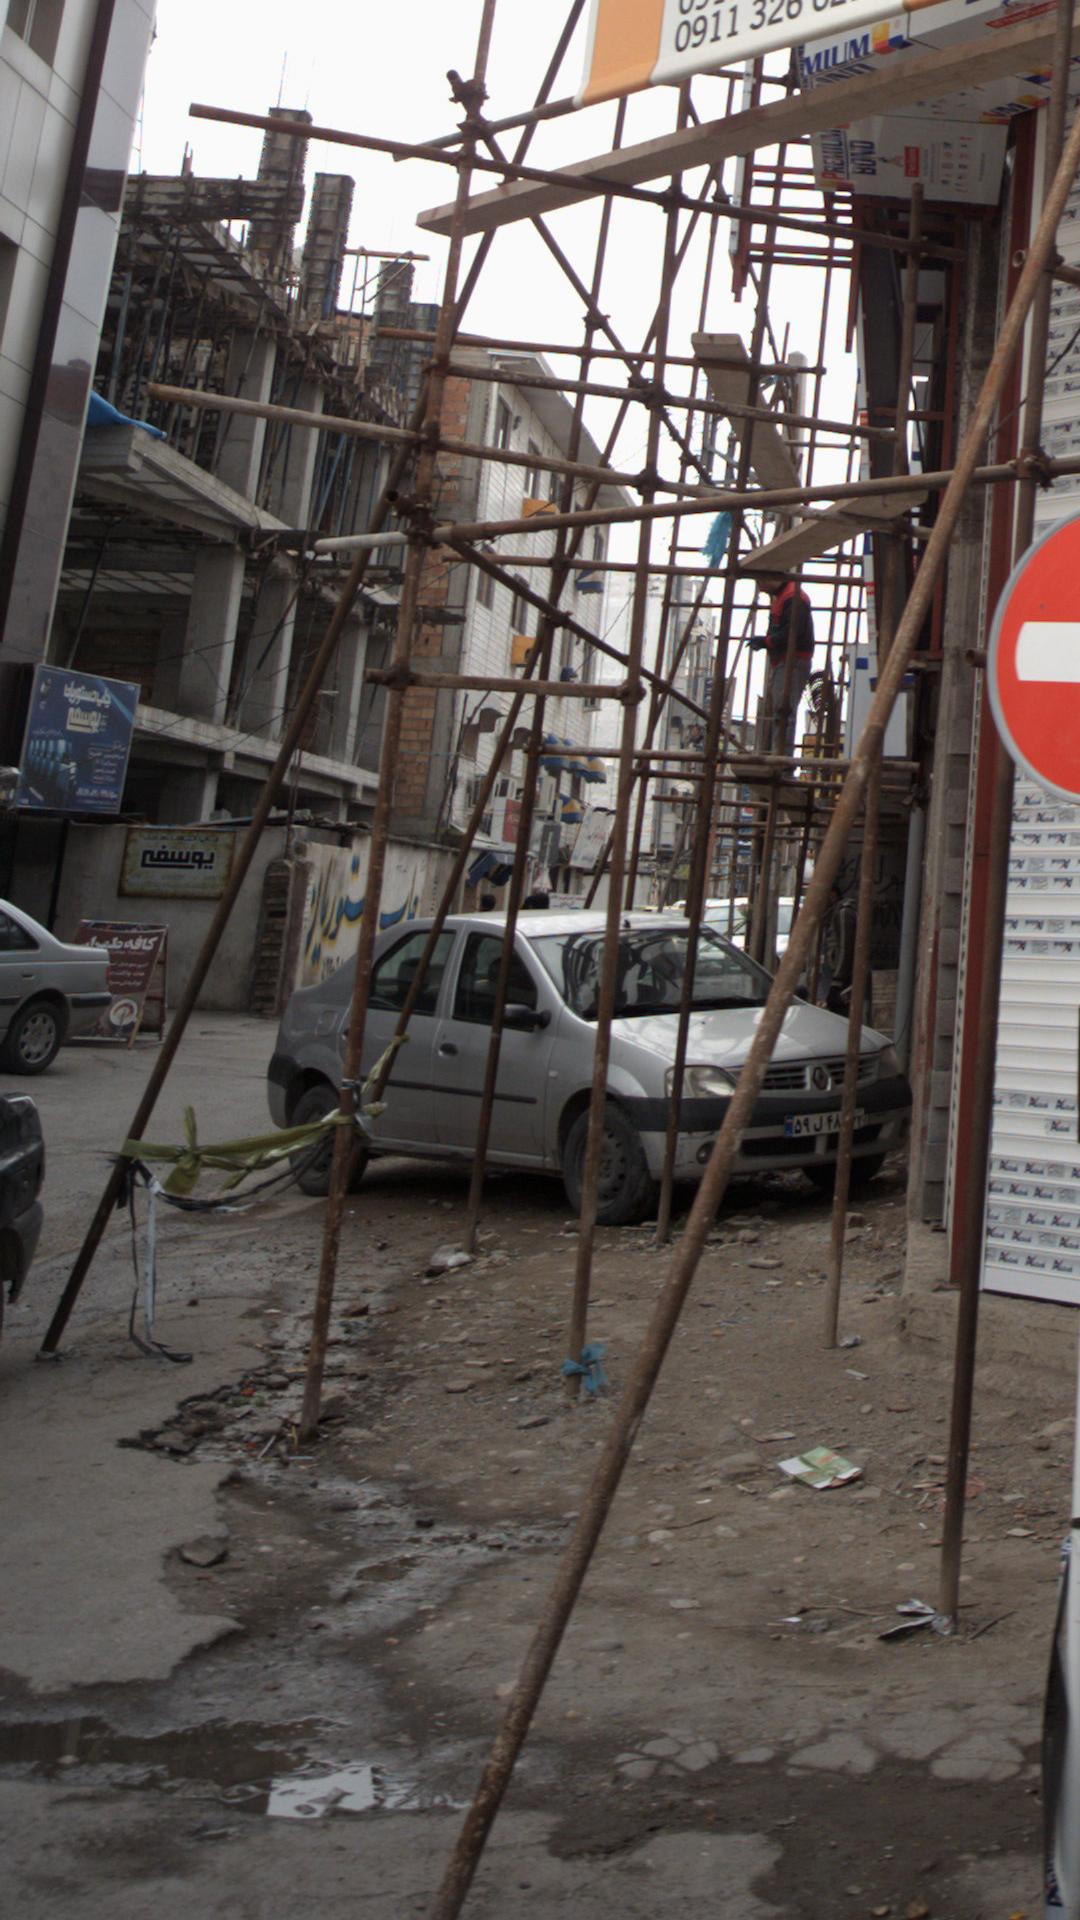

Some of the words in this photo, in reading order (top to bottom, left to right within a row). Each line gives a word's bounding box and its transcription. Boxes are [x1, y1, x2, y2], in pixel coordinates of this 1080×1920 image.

[675, 4, 739, 52] 0911
[749, 0, 803, 31] 326
[850, 140, 877, 176] BOND
[140, 844, 215, 870] یوسفی
[123, 935, 159, 950] کافه
